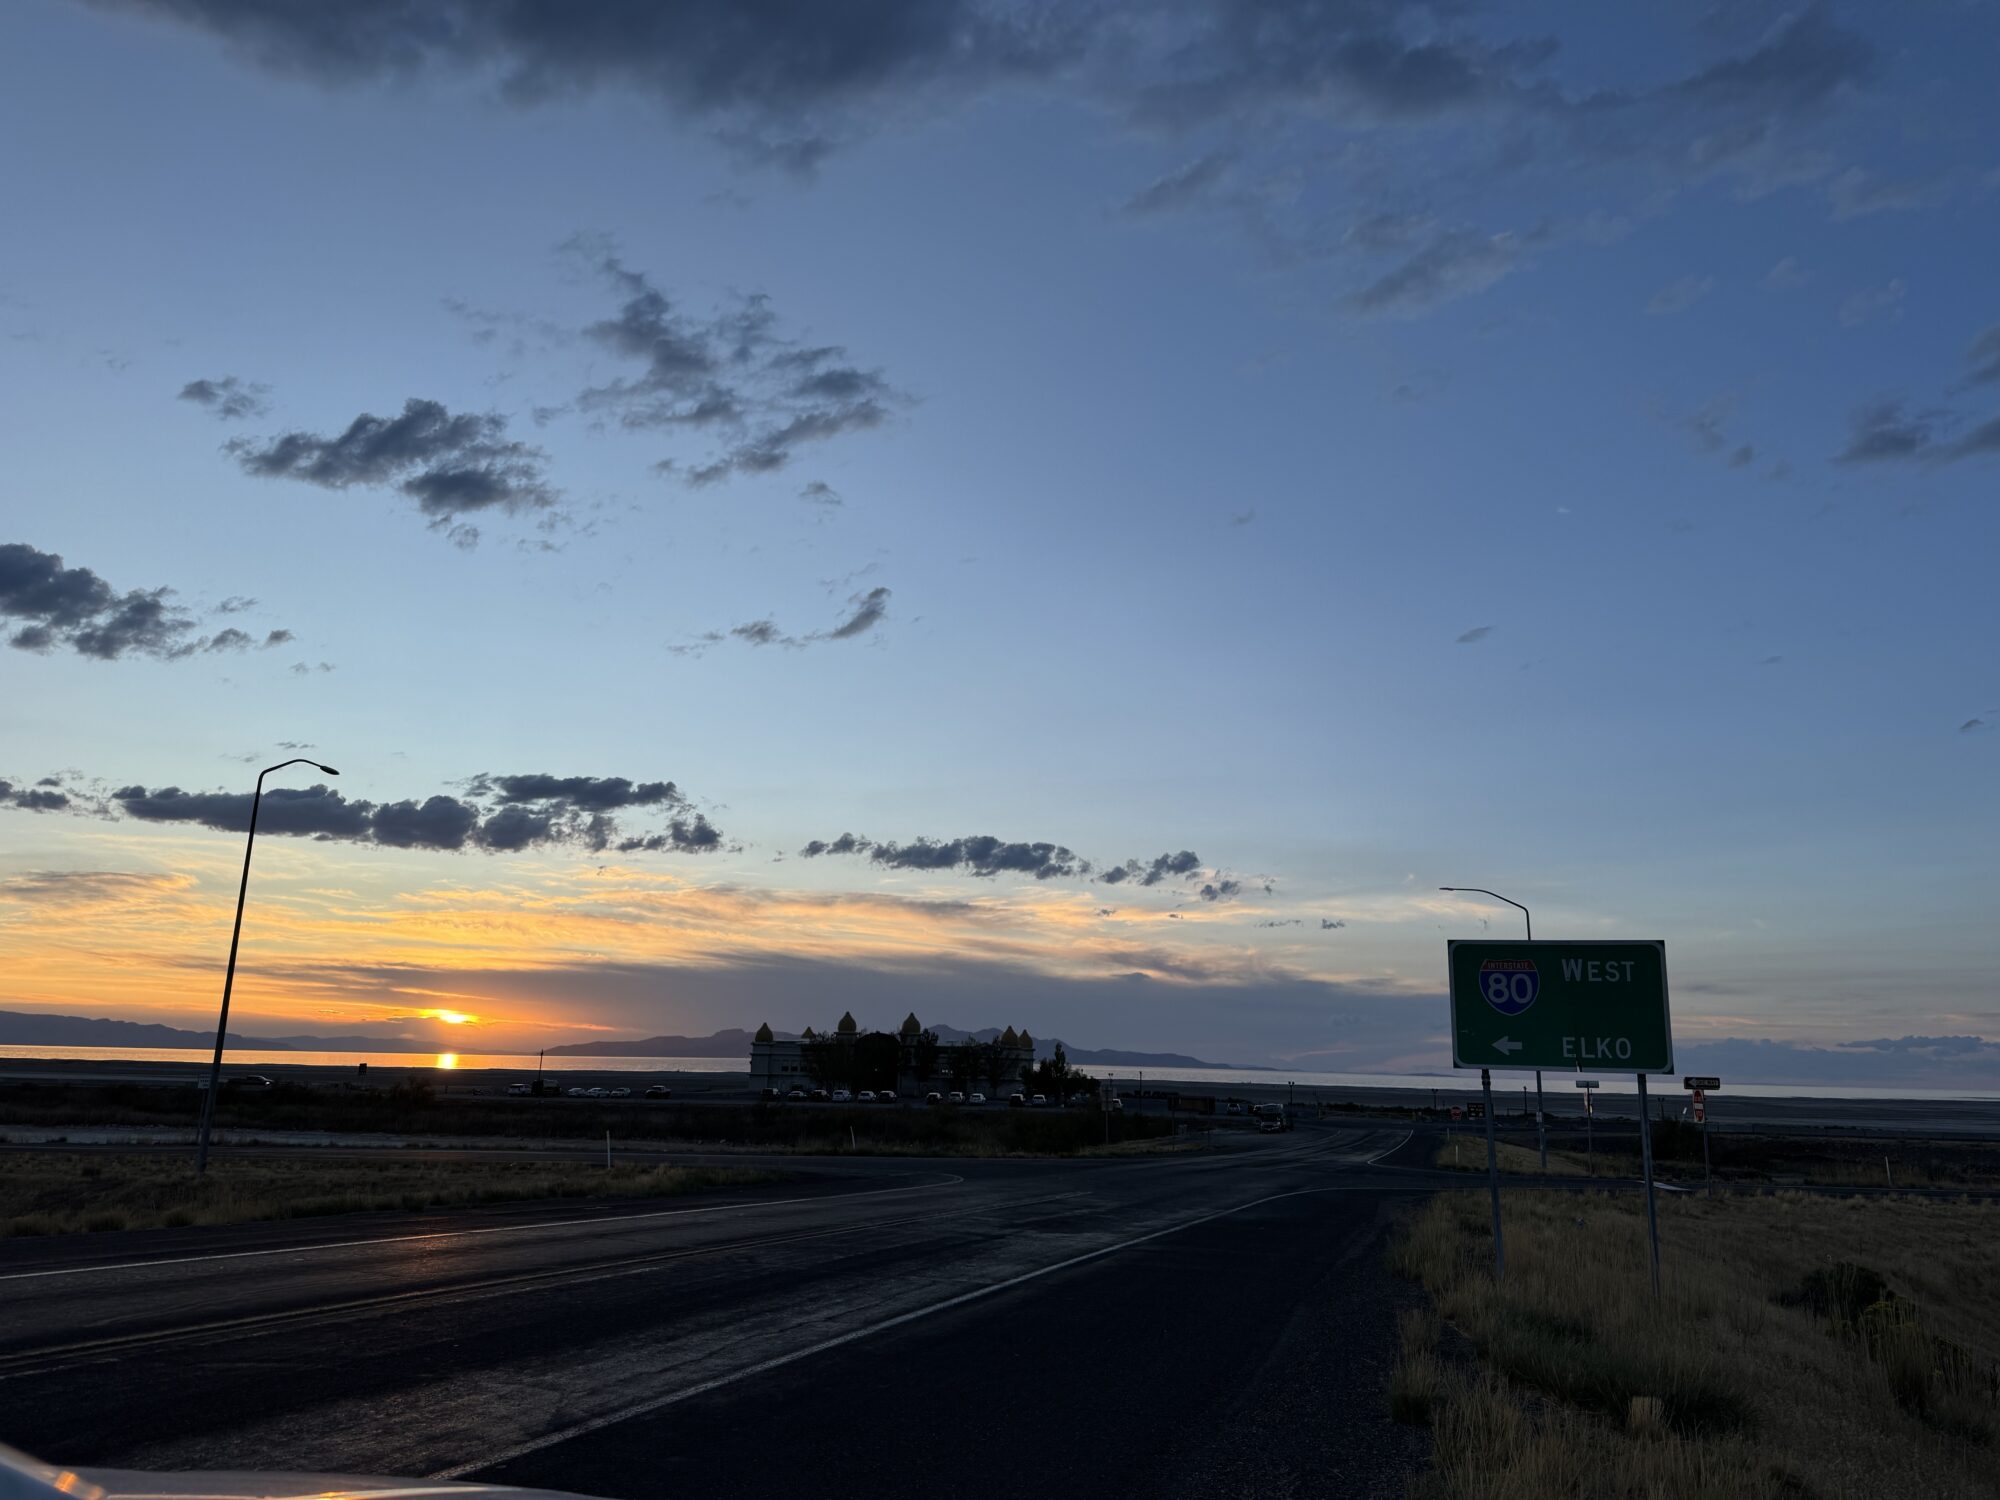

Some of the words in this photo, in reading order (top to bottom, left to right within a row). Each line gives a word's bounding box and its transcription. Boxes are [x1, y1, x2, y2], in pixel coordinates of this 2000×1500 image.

[1488, 961, 1528, 969] INTERSTATE
[1561, 958, 1635, 982] WEST
[1488, 972, 1533, 1004] 80
[1562, 1036, 1632, 1060] ELKO
